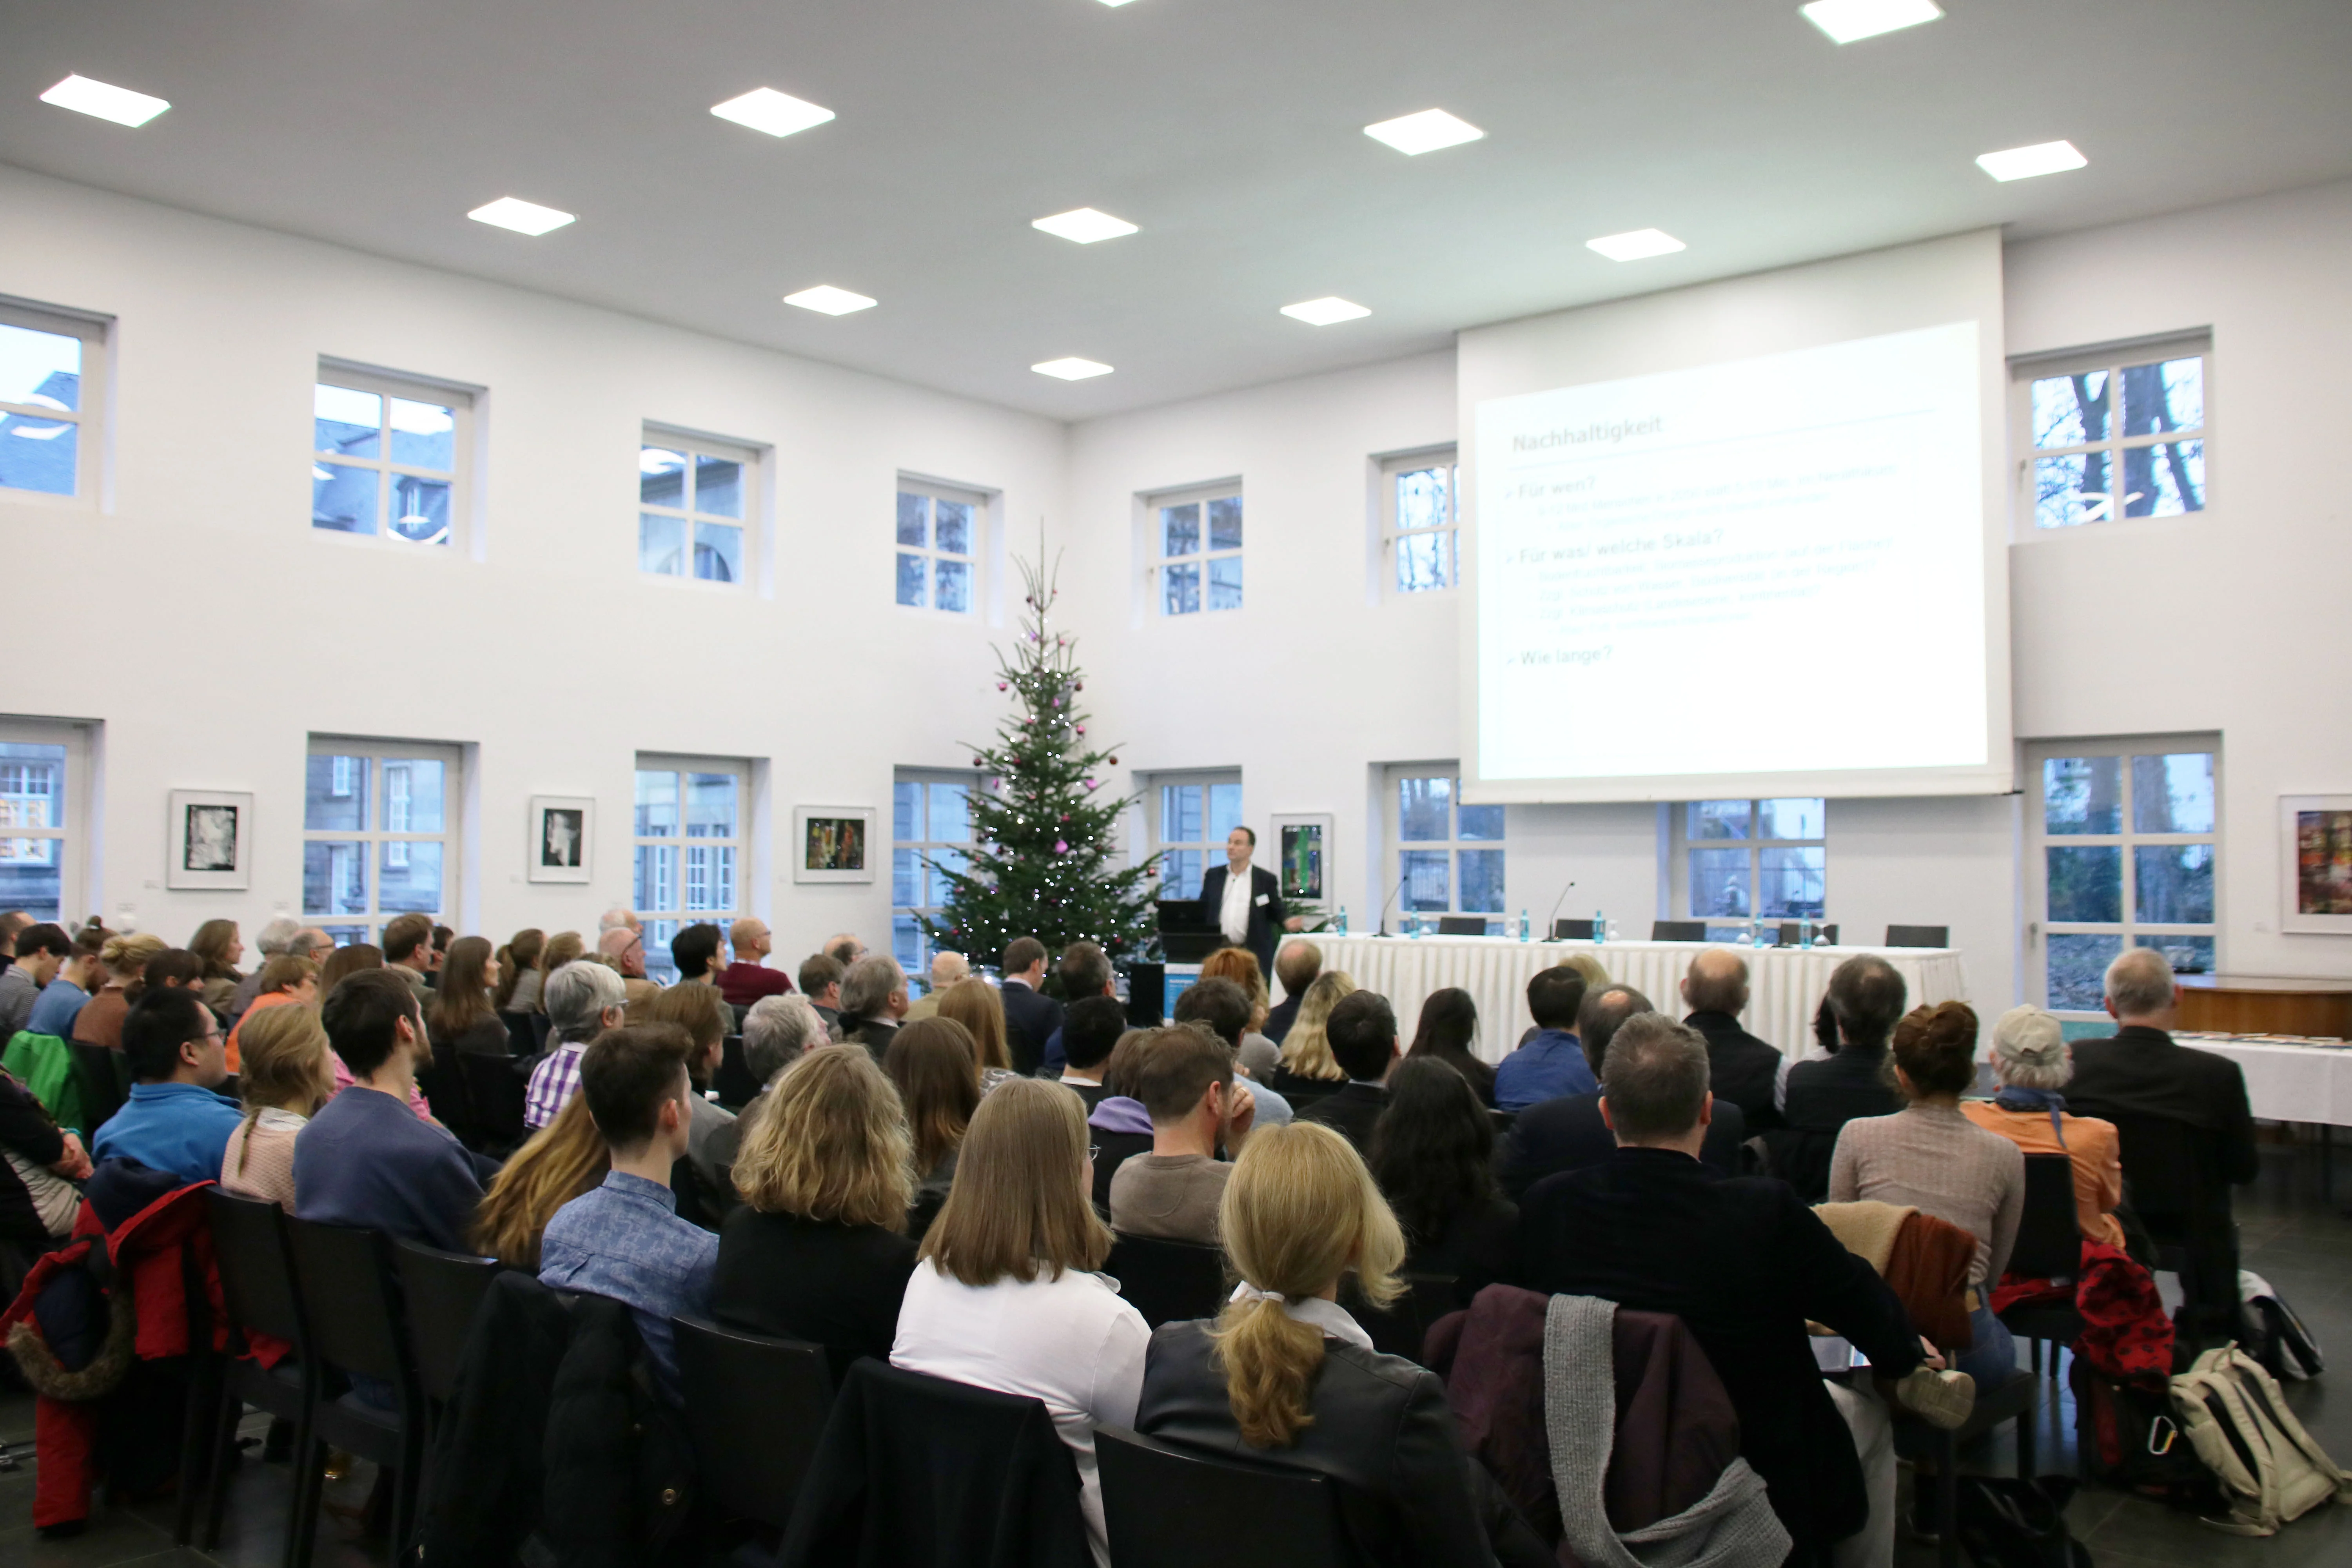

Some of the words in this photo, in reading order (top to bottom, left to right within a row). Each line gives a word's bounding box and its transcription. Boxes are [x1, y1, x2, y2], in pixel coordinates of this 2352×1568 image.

[1514, 415, 1664, 452] Nachhaltigkeit
[1519, 483, 1544, 499] Für
[1552, 474, 1596, 495] wen?
[1520, 546, 1546, 563] Für
[1597, 537, 1655, 555] welche
[1664, 528, 1724, 549] Skala?
[1520, 648, 1551, 664] Wie
[1556, 644, 1613, 666] lange?
